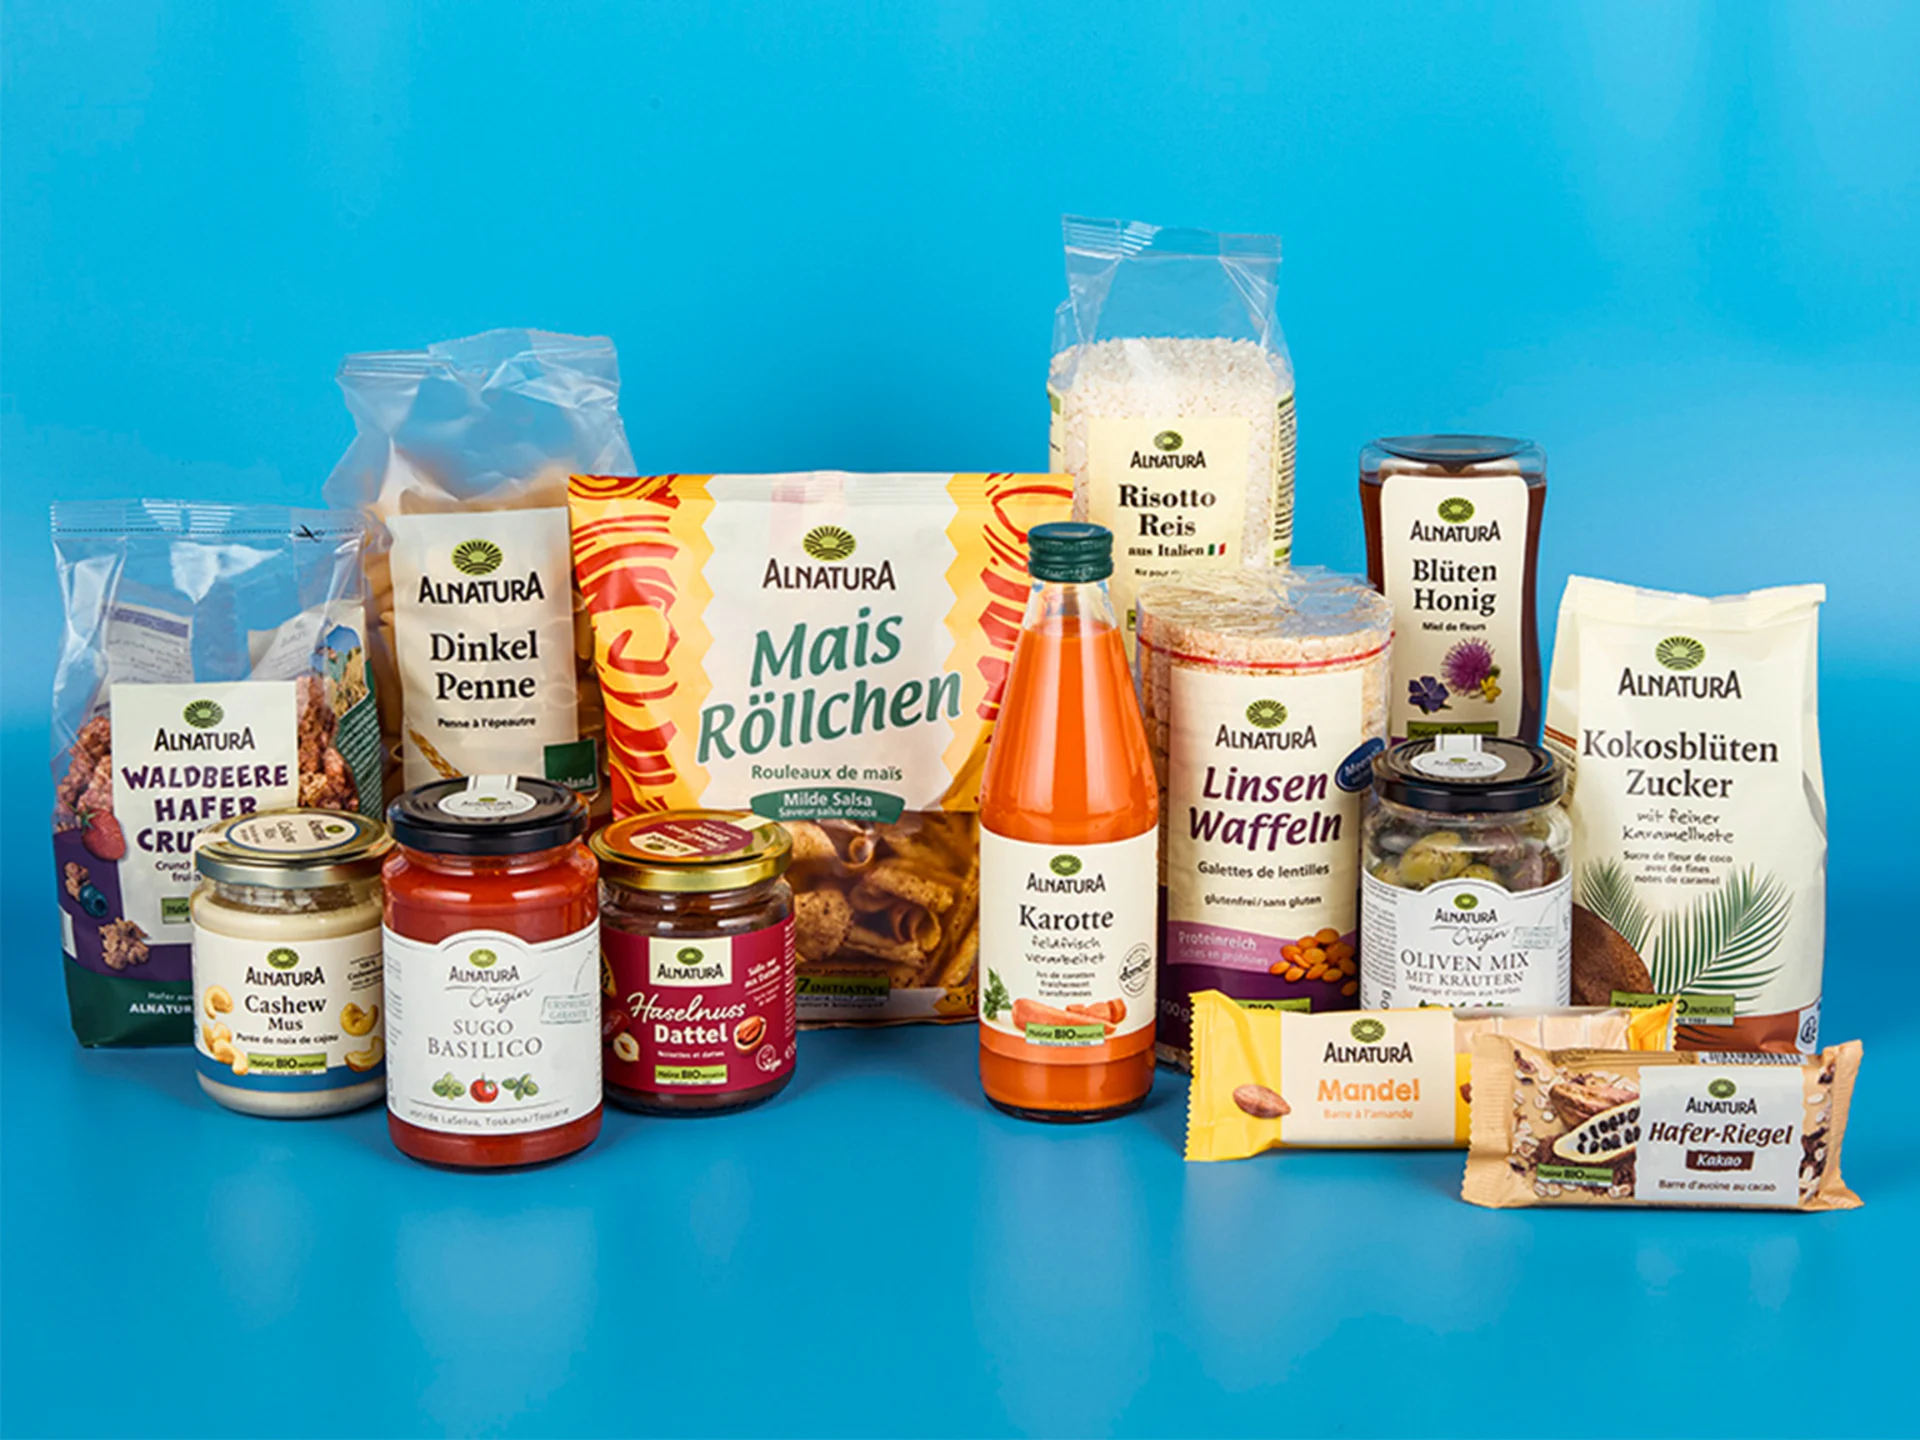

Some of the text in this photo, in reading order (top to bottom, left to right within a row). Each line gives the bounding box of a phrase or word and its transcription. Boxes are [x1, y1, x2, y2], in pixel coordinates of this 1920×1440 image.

[1130, 451, 1206, 469] ALNATURA
[1118, 484, 1216, 508] Risotto
[1139, 513, 1196, 537] Reis
[1410, 520, 1501, 542] ALNATURA
[1128, 544, 1204, 557] aus Italien
[762, 558, 896, 590] ALNATURA
[1412, 558, 1497, 582] Blüten
[419, 572, 544, 604] ALNATURA
[1413, 587, 1496, 617] Honig
[1422, 622, 1443, 631] Miel
[1445, 622, 1457, 631] de
[430, 630, 539, 662] Dinkel
[750, 606, 903, 688] Mais
[435, 672, 536, 700] Penne
[1618, 667, 1742, 699] ALNATURA
[437, 717, 469, 728] Penne
[473, 715, 480, 728] à
[698, 672, 961, 764] Röllchen
[154, 727, 255, 752] ALNATURA
[1215, 724, 1317, 750] ALNATURA
[1583, 728, 1780, 763] Kokosblüten
[121, 765, 289, 790] WALDBEERE
[751, 764, 902, 781] Rouleaux de maïs
[1202, 766, 1328, 803] Linsen
[1625, 768, 1734, 798] Zucker
[155, 796, 257, 822] HAFER
[784, 791, 873, 807] Milde Salsa
[778, 806, 816, 818] Saveur
[846, 807, 877, 818] douce
[1637, 808, 1720, 825] mit feiner
[1189, 807, 1342, 851] Waffeln
[1622, 826, 1735, 844] Karamellnote
[137, 829, 194, 853] CRU
[1623, 851, 1733, 863] Sucre de fleur de coco
[1198, 860, 1330, 878] Galettes de lentilles
[1669, 864, 1682, 874] de
[1026, 872, 1106, 894] ALNATURA
[1634, 875, 1720, 885] notes de caramel
[1288, 894, 1322, 908] gluten
[1019, 904, 1114, 930] Karotte
[1435, 908, 1498, 923] ALNATURA
[1031, 935, 1101, 949] feldfrisch
[1178, 931, 1257, 951] Proteinreich
[1452, 926, 1510, 951] Origin
[1026, 952, 1105, 965] verarbeitet
[1401, 949, 1530, 971] OLIVEN MIX
[245, 966, 325, 986] ALNATURA
[449, 965, 520, 982] ALNATURA
[657, 963, 724, 980] ALNATURA
[1405, 969, 1523, 987] MIT KRÄUTERN
[129, 1003, 193, 1014] ALNATUR
[245, 995, 327, 1014] Cashew
[469, 987, 534, 1013] Origin
[627, 992, 747, 1023] Haselnuss
[268, 1017, 303, 1031] Mus
[453, 1019, 514, 1036] SUGO
[654, 1022, 728, 1044] Dattel
[262, 1035, 274, 1044] de
[299, 1034, 311, 1044] de
[428, 1037, 543, 1059] BASILICO
[1323, 1042, 1413, 1063] ALNATURA
[276, 1058, 297, 1069] BIO
[1318, 1079, 1420, 1102] Mandel
[1323, 1109, 1352, 1119] Barre
[1355, 1108, 1362, 1119] à
[1685, 1097, 1758, 1115] ALNATURA
[1648, 1122, 1795, 1149] Hafer-Riegel
[1696, 1154, 1743, 1167] Kakao
[1658, 1179, 1776, 1192] Barre d'avoine au cacao
